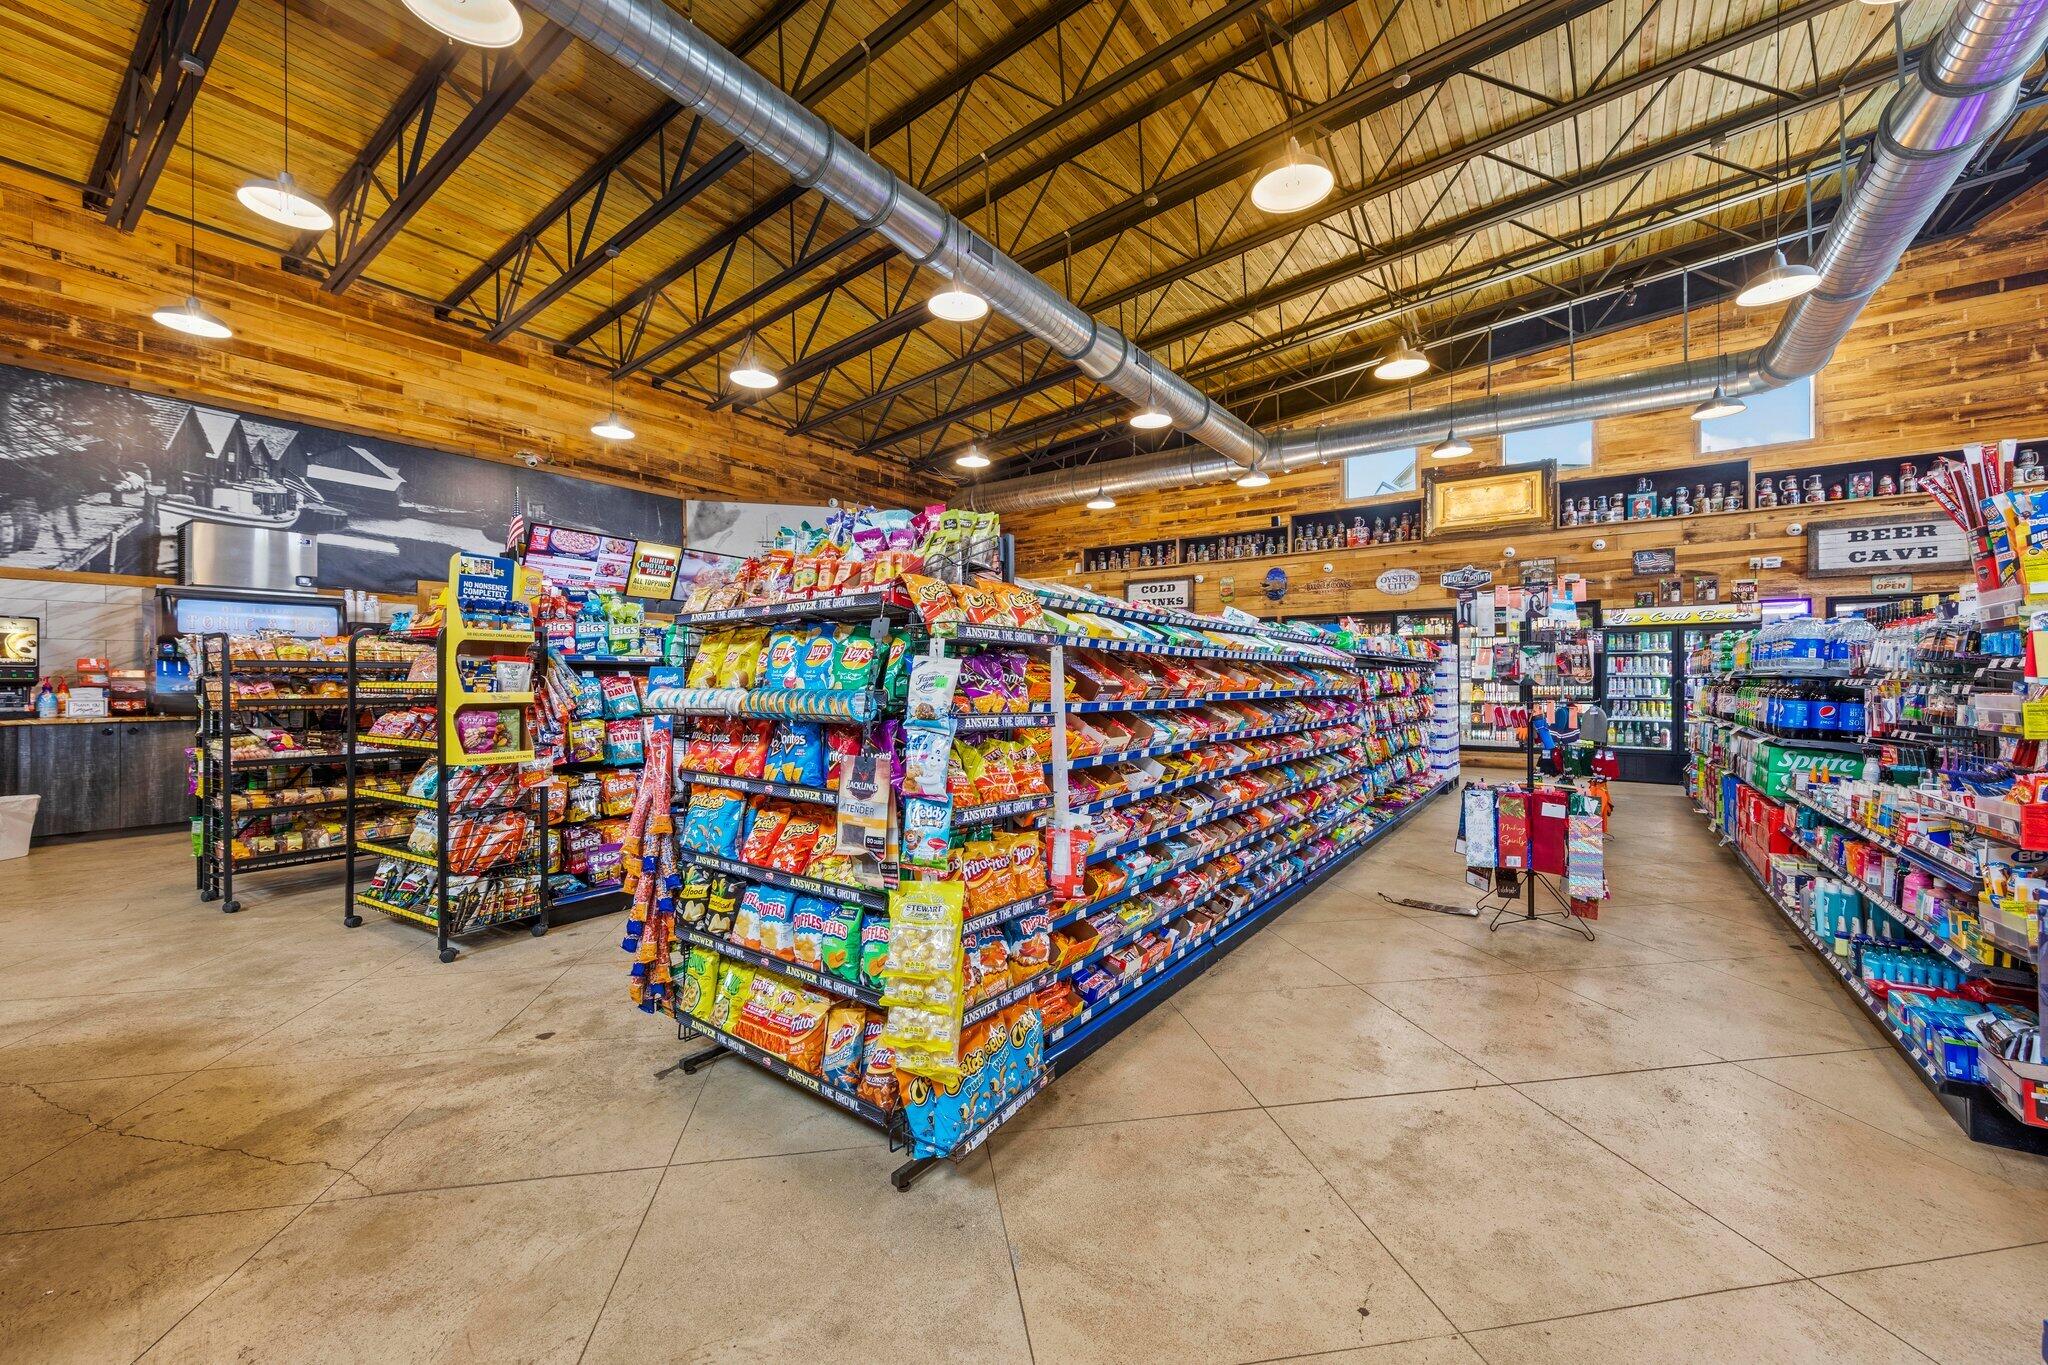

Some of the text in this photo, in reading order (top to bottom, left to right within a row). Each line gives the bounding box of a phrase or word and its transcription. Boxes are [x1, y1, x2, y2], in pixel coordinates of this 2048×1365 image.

[1848, 525, 1937, 542] BEER
[1848, 546, 1938, 563] CAVE
[646, 568, 667, 576] PIZZA
[1380, 575, 1416, 584] OYSTER
[633, 577, 671, 588] ALL TOPPINGS
[1141, 584, 1176, 594] COLD
[1388, 582, 1409, 590] CITY
[1875, 582, 1906, 591] OPEN
[463, 588, 508, 598] COMPLETELY
[786, 596, 857, 613] ANSWER THE GROWL
[1147, 597, 1184, 606] RINKS
[186, 614, 255, 632] TONIC
[691, 608, 746, 623] ANSWER THE GROWL
[1612, 610, 1751, 624] Ice Cold Beer
[965, 626, 1037, 642] ANSWER THE GROWL
[607, 684, 633, 698] DAVID
[965, 716, 1036, 728] ANSWER THE GROWL
[612, 731, 639, 743] DAVID
[1777, 751, 1858, 775] Sprite
[695, 774, 750, 790] ANSWER THE GROWL
[789, 788, 834, 803] ANSWER THE
[846, 803, 875, 815] TENDER
[911, 804, 948, 820] Teddy
[962, 800, 1035, 822] ANSWER THE GROWL
[989, 854, 1011, 871] itos
[2019, 850, 2044, 862] BC
[695, 855, 750, 875] ANSWER THE GROWL
[789, 878, 861, 902] ANSWER THE GROWL
[905, 904, 942, 913] STEWART
[963, 899, 1035, 934] ANSWER THE GROWL
[793, 912, 823, 930] RUFFLES
[689, 933, 745, 959] ANSWER THE GROWL
[785, 965, 859, 998] ANSWER THE GROWL
[963, 982, 1036, 1024] ANSWER THE GROWL
[865, 1021, 883, 1037] itos
[691, 1021, 747, 1054] ANSWER THE GROWL
[787, 1069, 860, 1111] ANSWER THE GROWL
